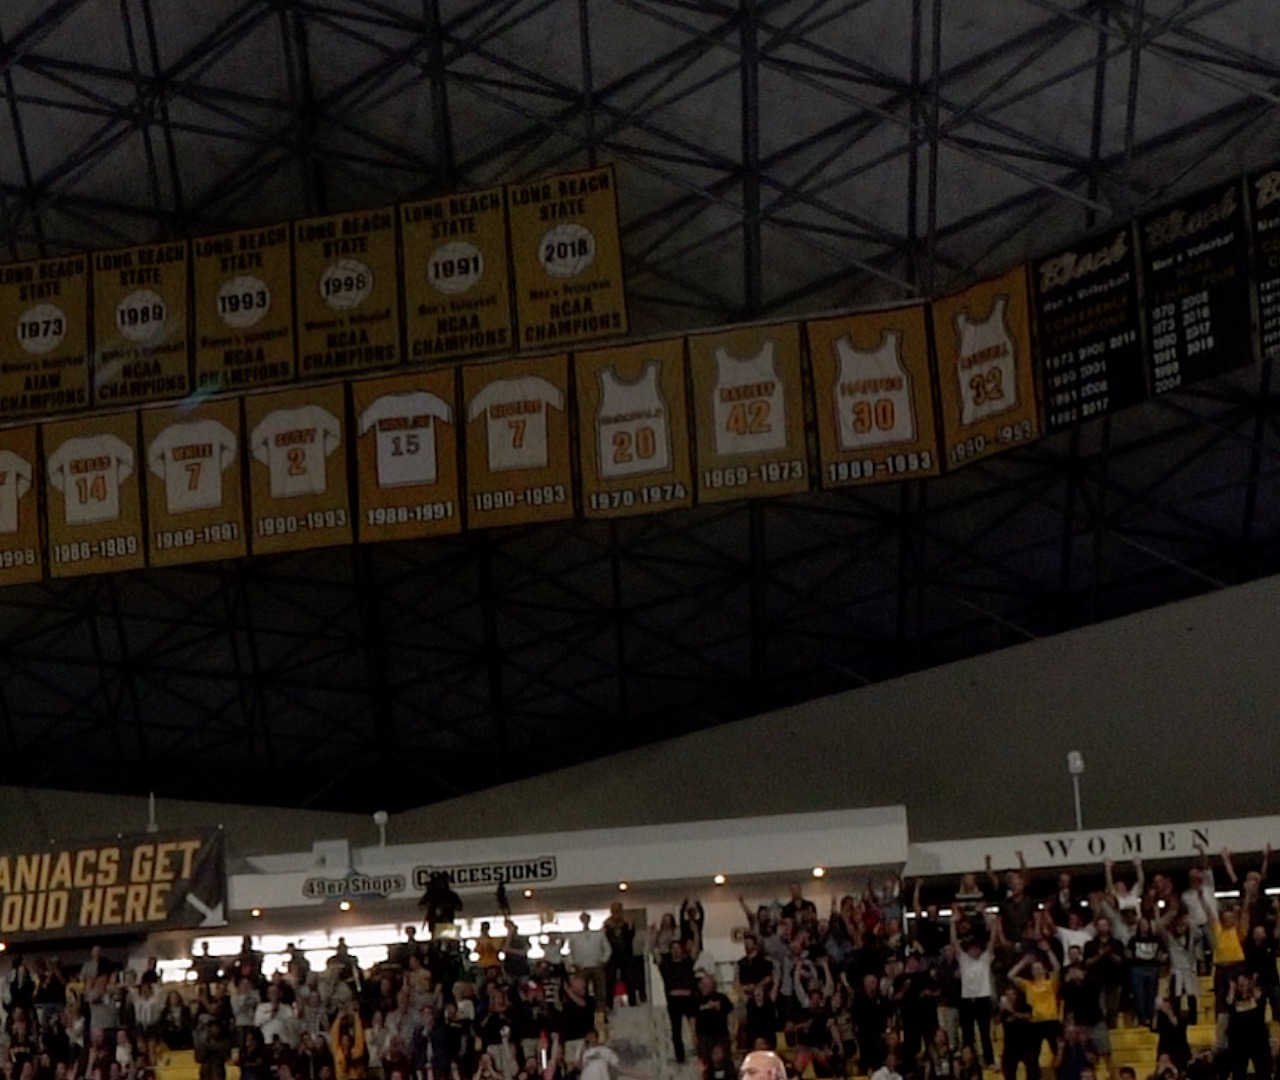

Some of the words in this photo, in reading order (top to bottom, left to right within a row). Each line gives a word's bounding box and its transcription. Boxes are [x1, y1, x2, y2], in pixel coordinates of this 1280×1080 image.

[512, 185, 552, 206] LONG
[559, 173, 610, 198] BEACH
[405, 204, 444, 223] LONG
[448, 193, 500, 216] BEACH
[540, 198, 587, 221] STATE
[298, 223, 336, 242] LONG
[343, 213, 390, 234] BEACH
[432, 217, 477, 239] STATE
[196, 236, 233, 258] LONG
[239, 225, 288, 250] BEACH
[323, 236, 367, 257] STATE
[545, 239, 589, 263] 2018
[39, 259, 85, 278] BEACH
[96, 253, 132, 273] LONG
[139, 245, 185, 265] BEACH
[221, 252, 264, 272] STATE
[120, 270, 162, 287] STATE
[323, 273, 366, 295] 1998
[20, 283, 61, 302] STATE
[219, 290, 267, 313] 1993
[119, 303, 163, 326] 1989
[550, 295, 594, 318] NCAA
[20, 318, 63, 339] 1973
[436, 313, 480, 335] NCAA
[525, 311, 621, 343] CHAMPIONS
[327, 328, 369, 349] NCAA
[412, 327, 508, 354] CHAMPIONS
[122, 360, 162, 379] NCAA
[223, 348, 264, 366] NCAA
[303, 344, 395, 371] CHAMPIONS
[24, 372, 61, 390] AIAW
[200, 362, 290, 386] CHAMPIONS
[970, 367, 1005, 405] 32
[0, 388, 85, 412] CHAMPIONS
[98, 376, 186, 400] CHAMPIONS
[725, 401, 771, 435] 42
[853, 399, 895, 432] 30
[390, 435, 420, 456] 15
[509, 419, 526, 449] 7
[612, 427, 656, 463] 20
[286, 448, 306, 476] 2
[185, 463, 203, 491] 7
[704, 461, 803, 489] 1969-1973
[77, 476, 108, 504] 14
[475, 484, 565, 511] 1990-1993
[258, 509, 347, 536] 1990-1993
[367, 502, 454, 525] 1988-1991
[157, 522, 239, 549] 1989-1991
[54, 537, 137, 563] 1986-1989
[1043, 829, 1210, 858] WOMEN
[130, 840, 201, 883] GET
[306, 880, 346, 896] 49er
[351, 876, 402, 896] Shops
[79, 882, 171, 927] HERE
